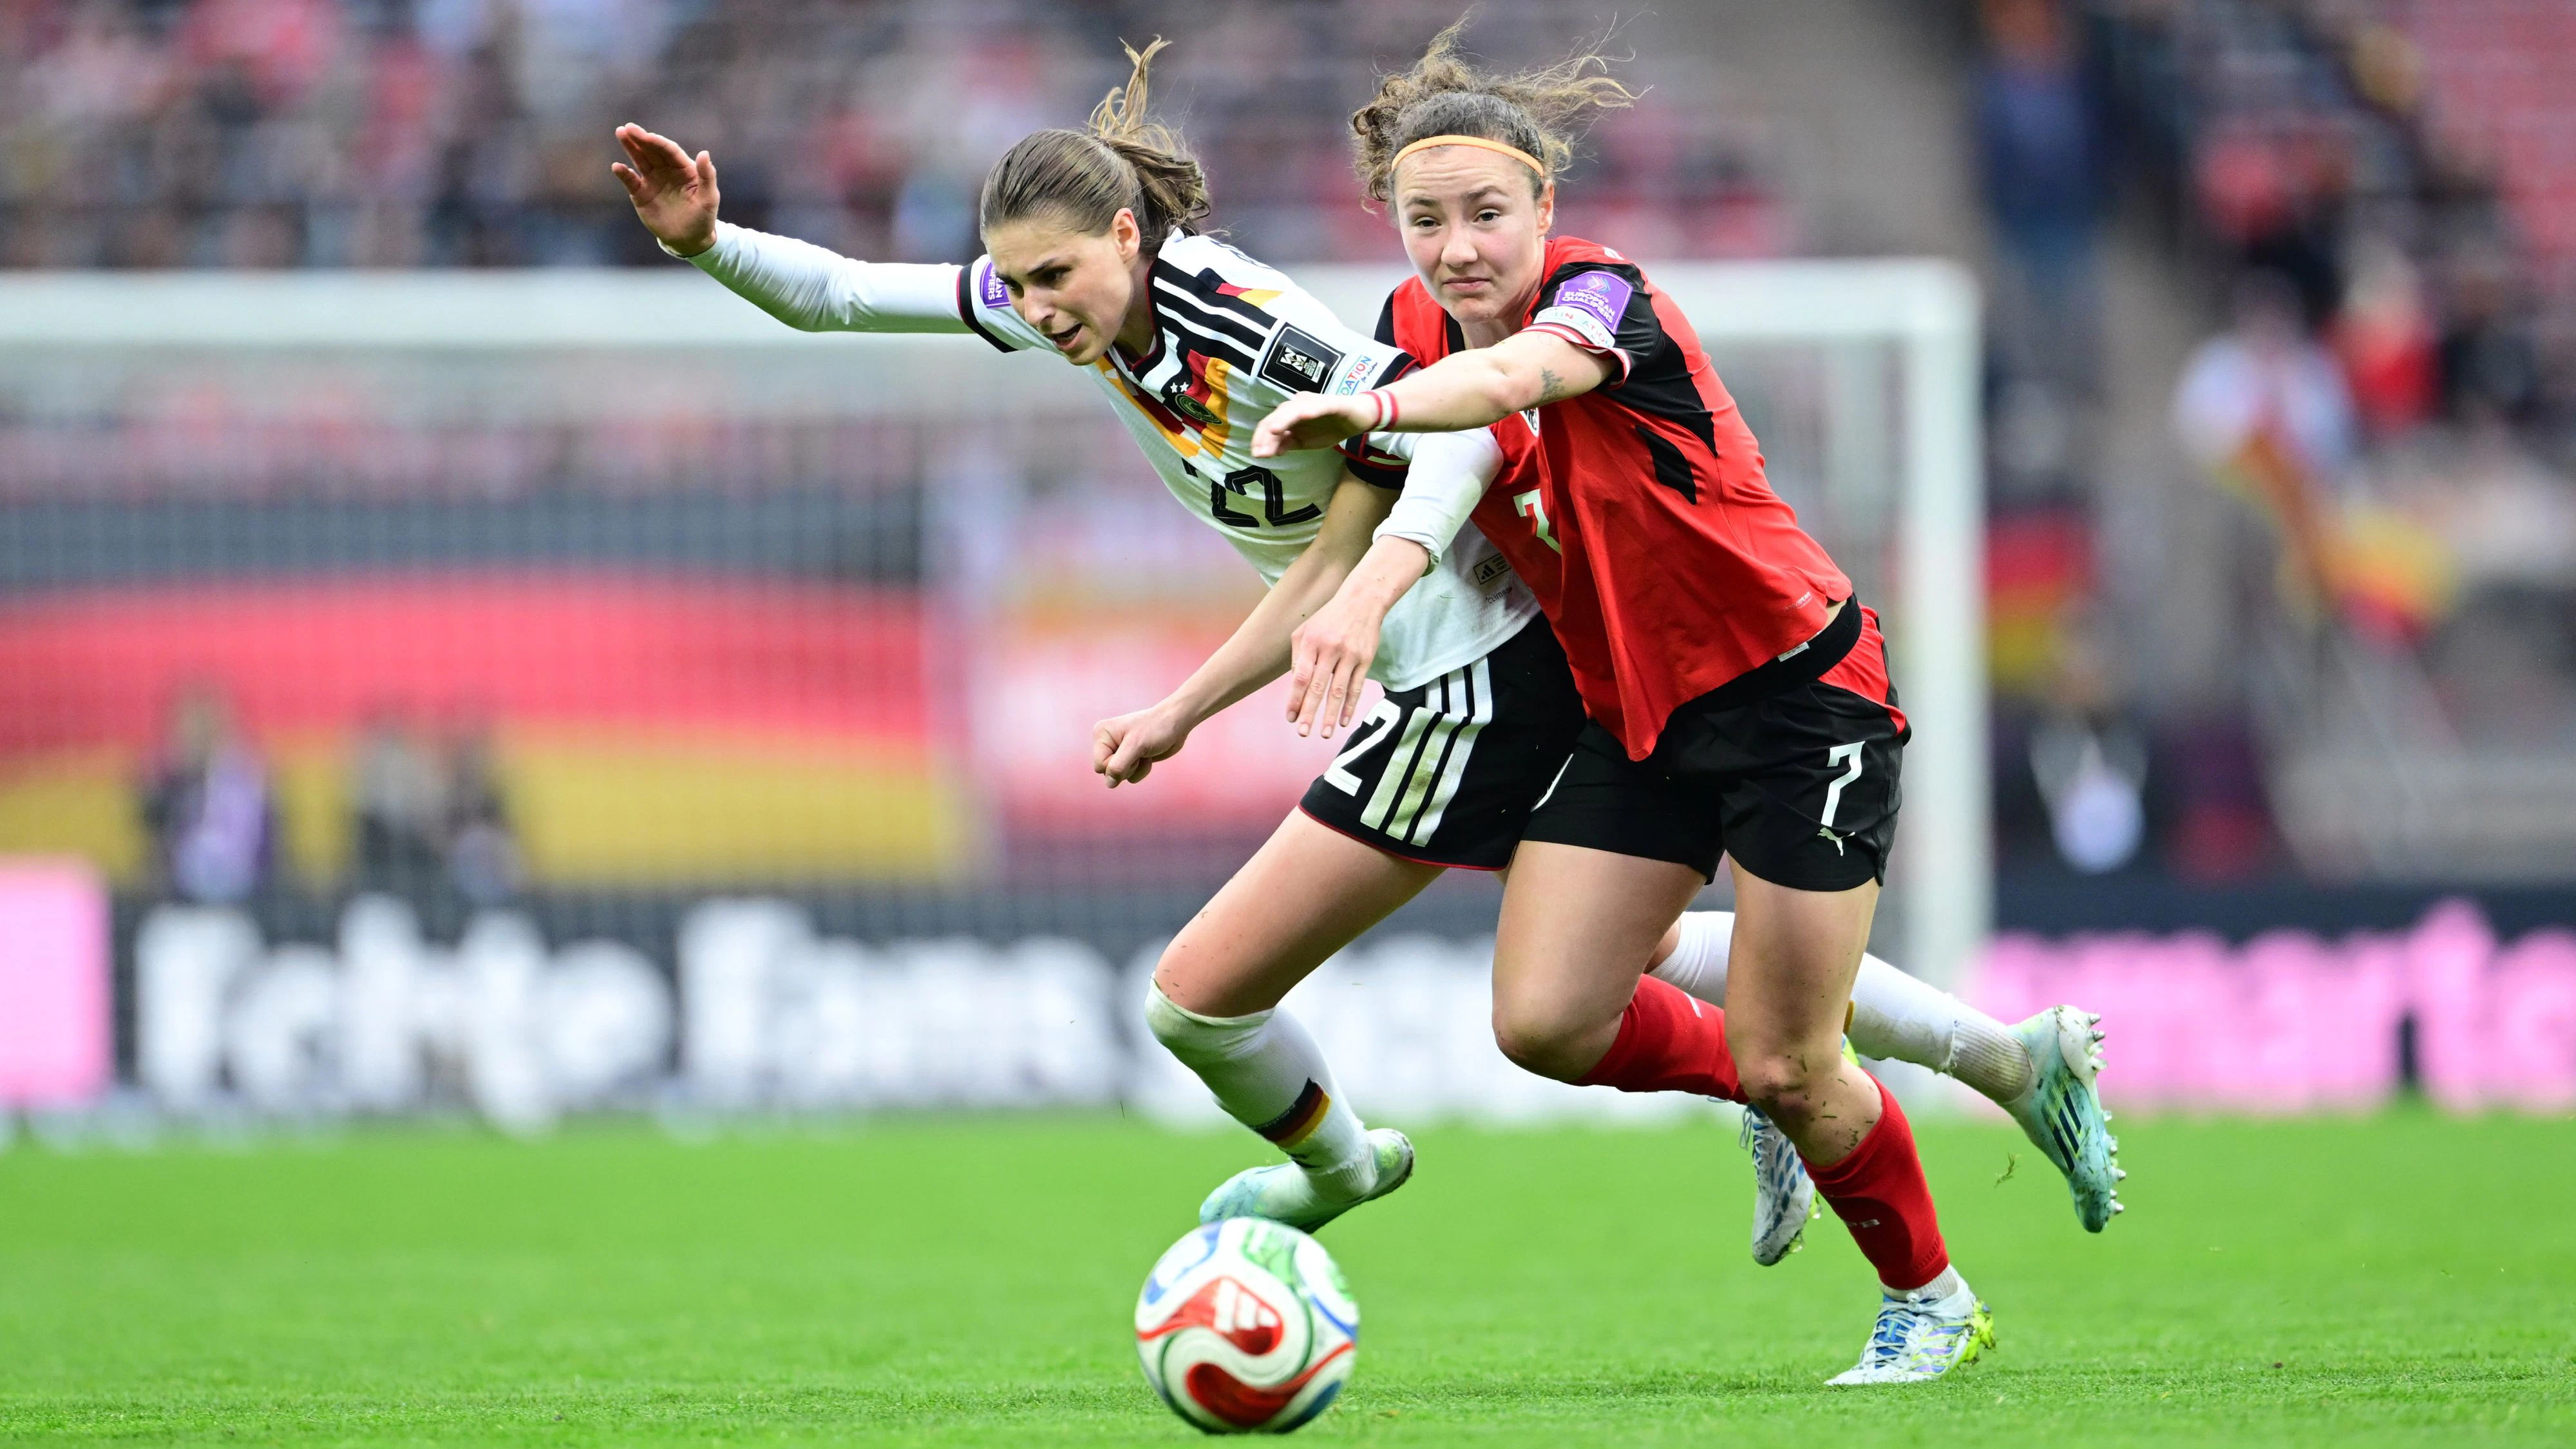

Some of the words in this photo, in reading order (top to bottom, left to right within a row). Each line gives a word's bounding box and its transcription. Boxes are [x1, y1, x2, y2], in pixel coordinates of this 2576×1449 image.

[1562, 296, 1614, 324] QUALIFIERS
[1565, 291, 1615, 317] EUROPEAN
[1340, 355, 1372, 395] DATION
[1513, 488, 1562, 555] 7
[1323, 697, 1401, 797] 2
[1821, 741, 1866, 827] 7
